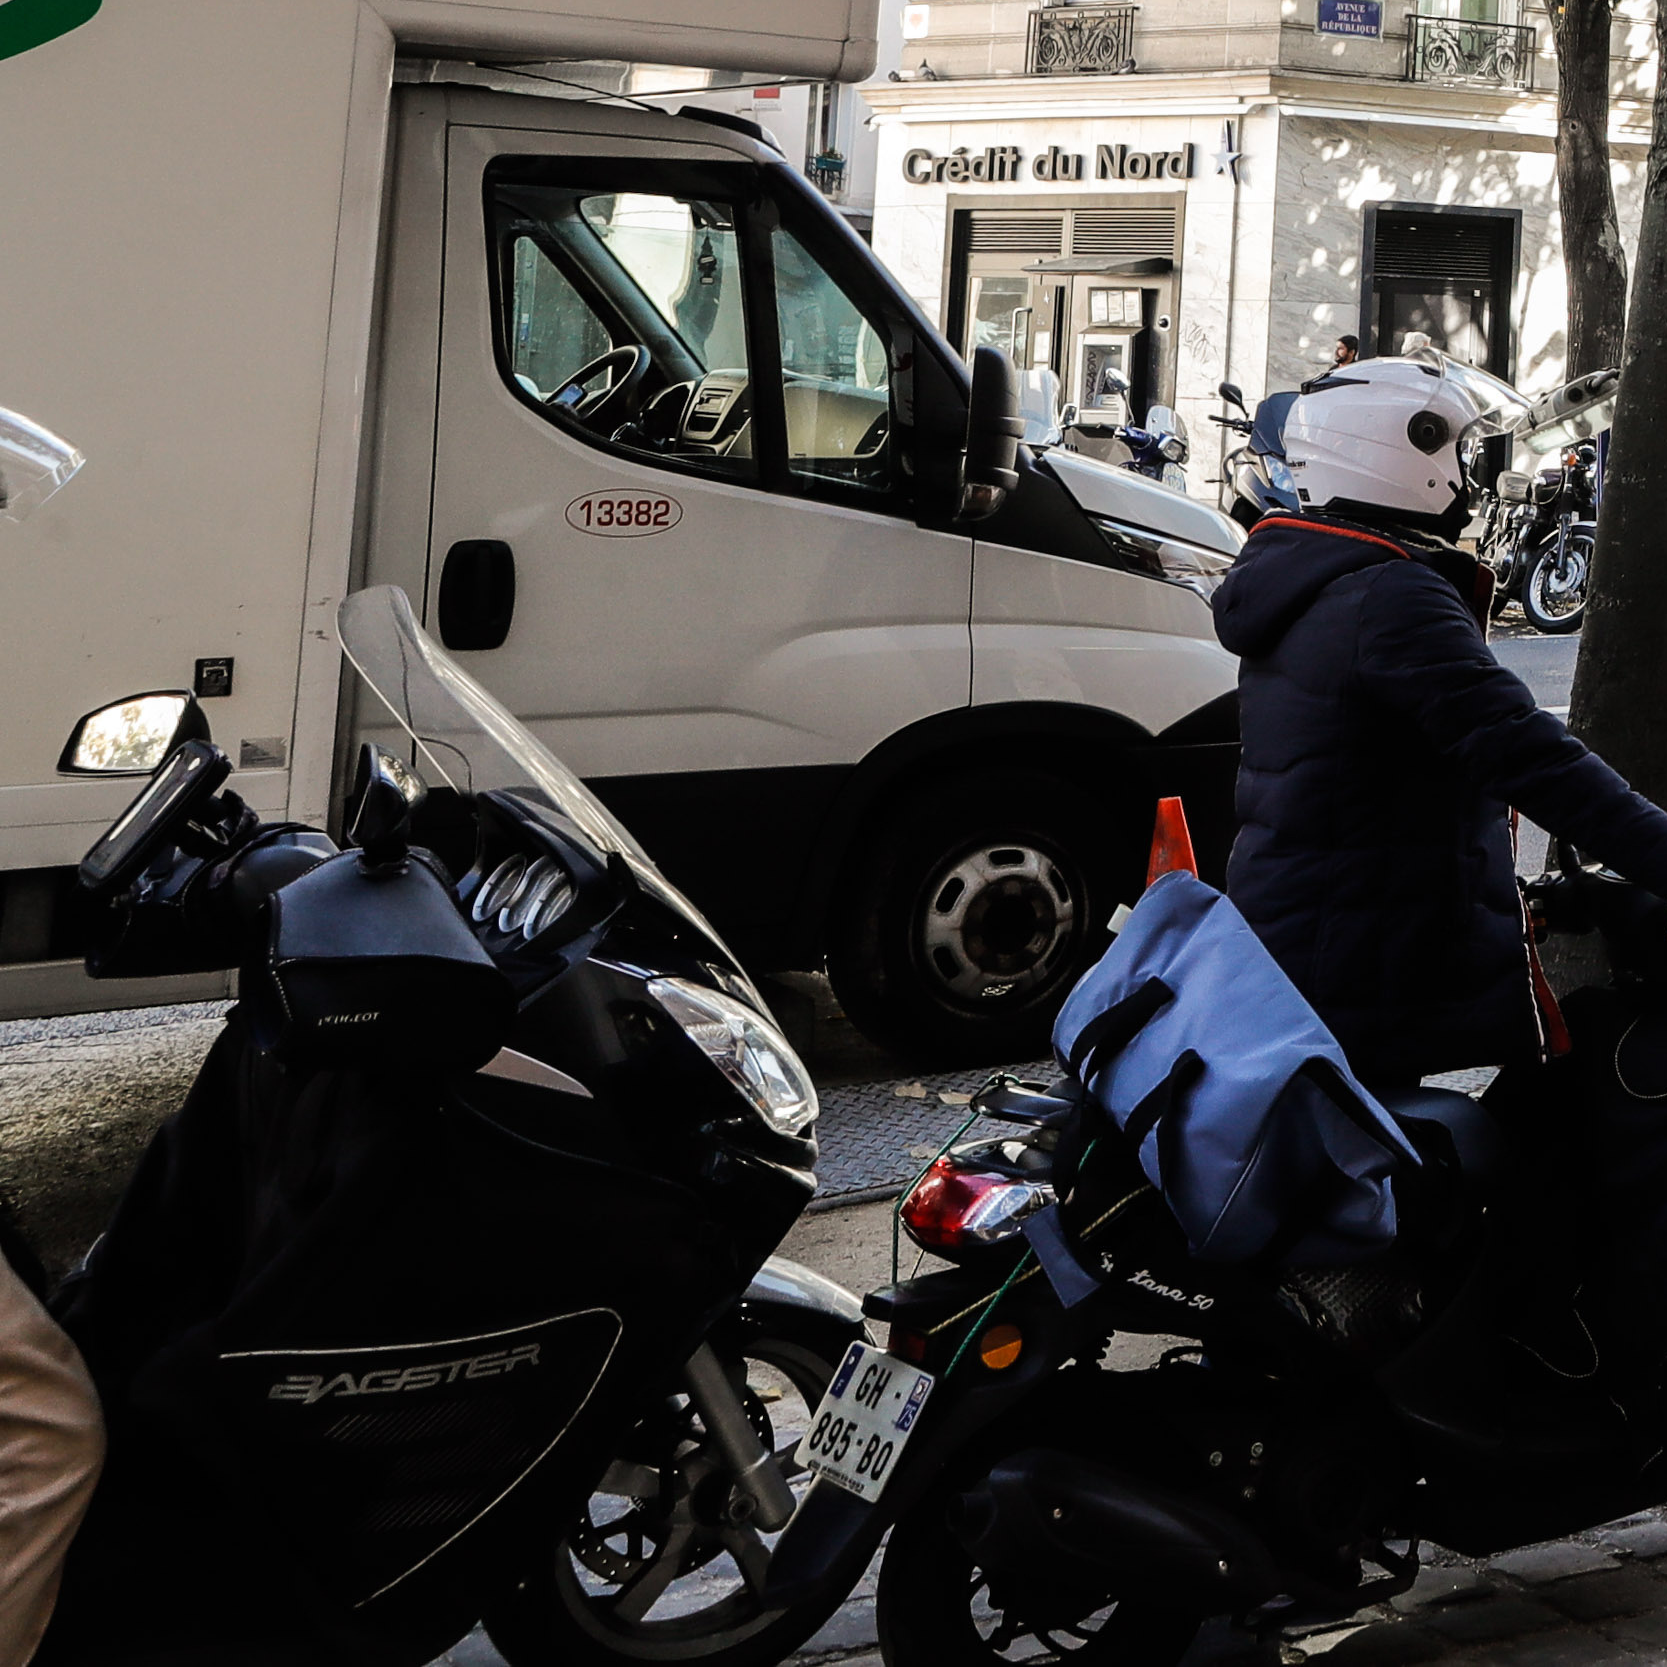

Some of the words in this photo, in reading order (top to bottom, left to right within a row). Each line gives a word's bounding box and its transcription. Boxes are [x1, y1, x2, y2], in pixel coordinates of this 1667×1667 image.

[1336, 2, 1366, 13] AVENUE
[1337, 13, 1349, 22] DE
[1350, 14, 1362, 23] LA
[1321, 20, 1377, 34] RÉPUBLIQUE
[902, 145, 1021, 184] Crédit
[1032, 145, 1083, 181] du
[1095, 142, 1194, 180] Nord
[580, 499, 670, 526] 13382
[1188, 1294, 1214, 1310] 50
[268, 1343, 541, 1404] BAGSTER
